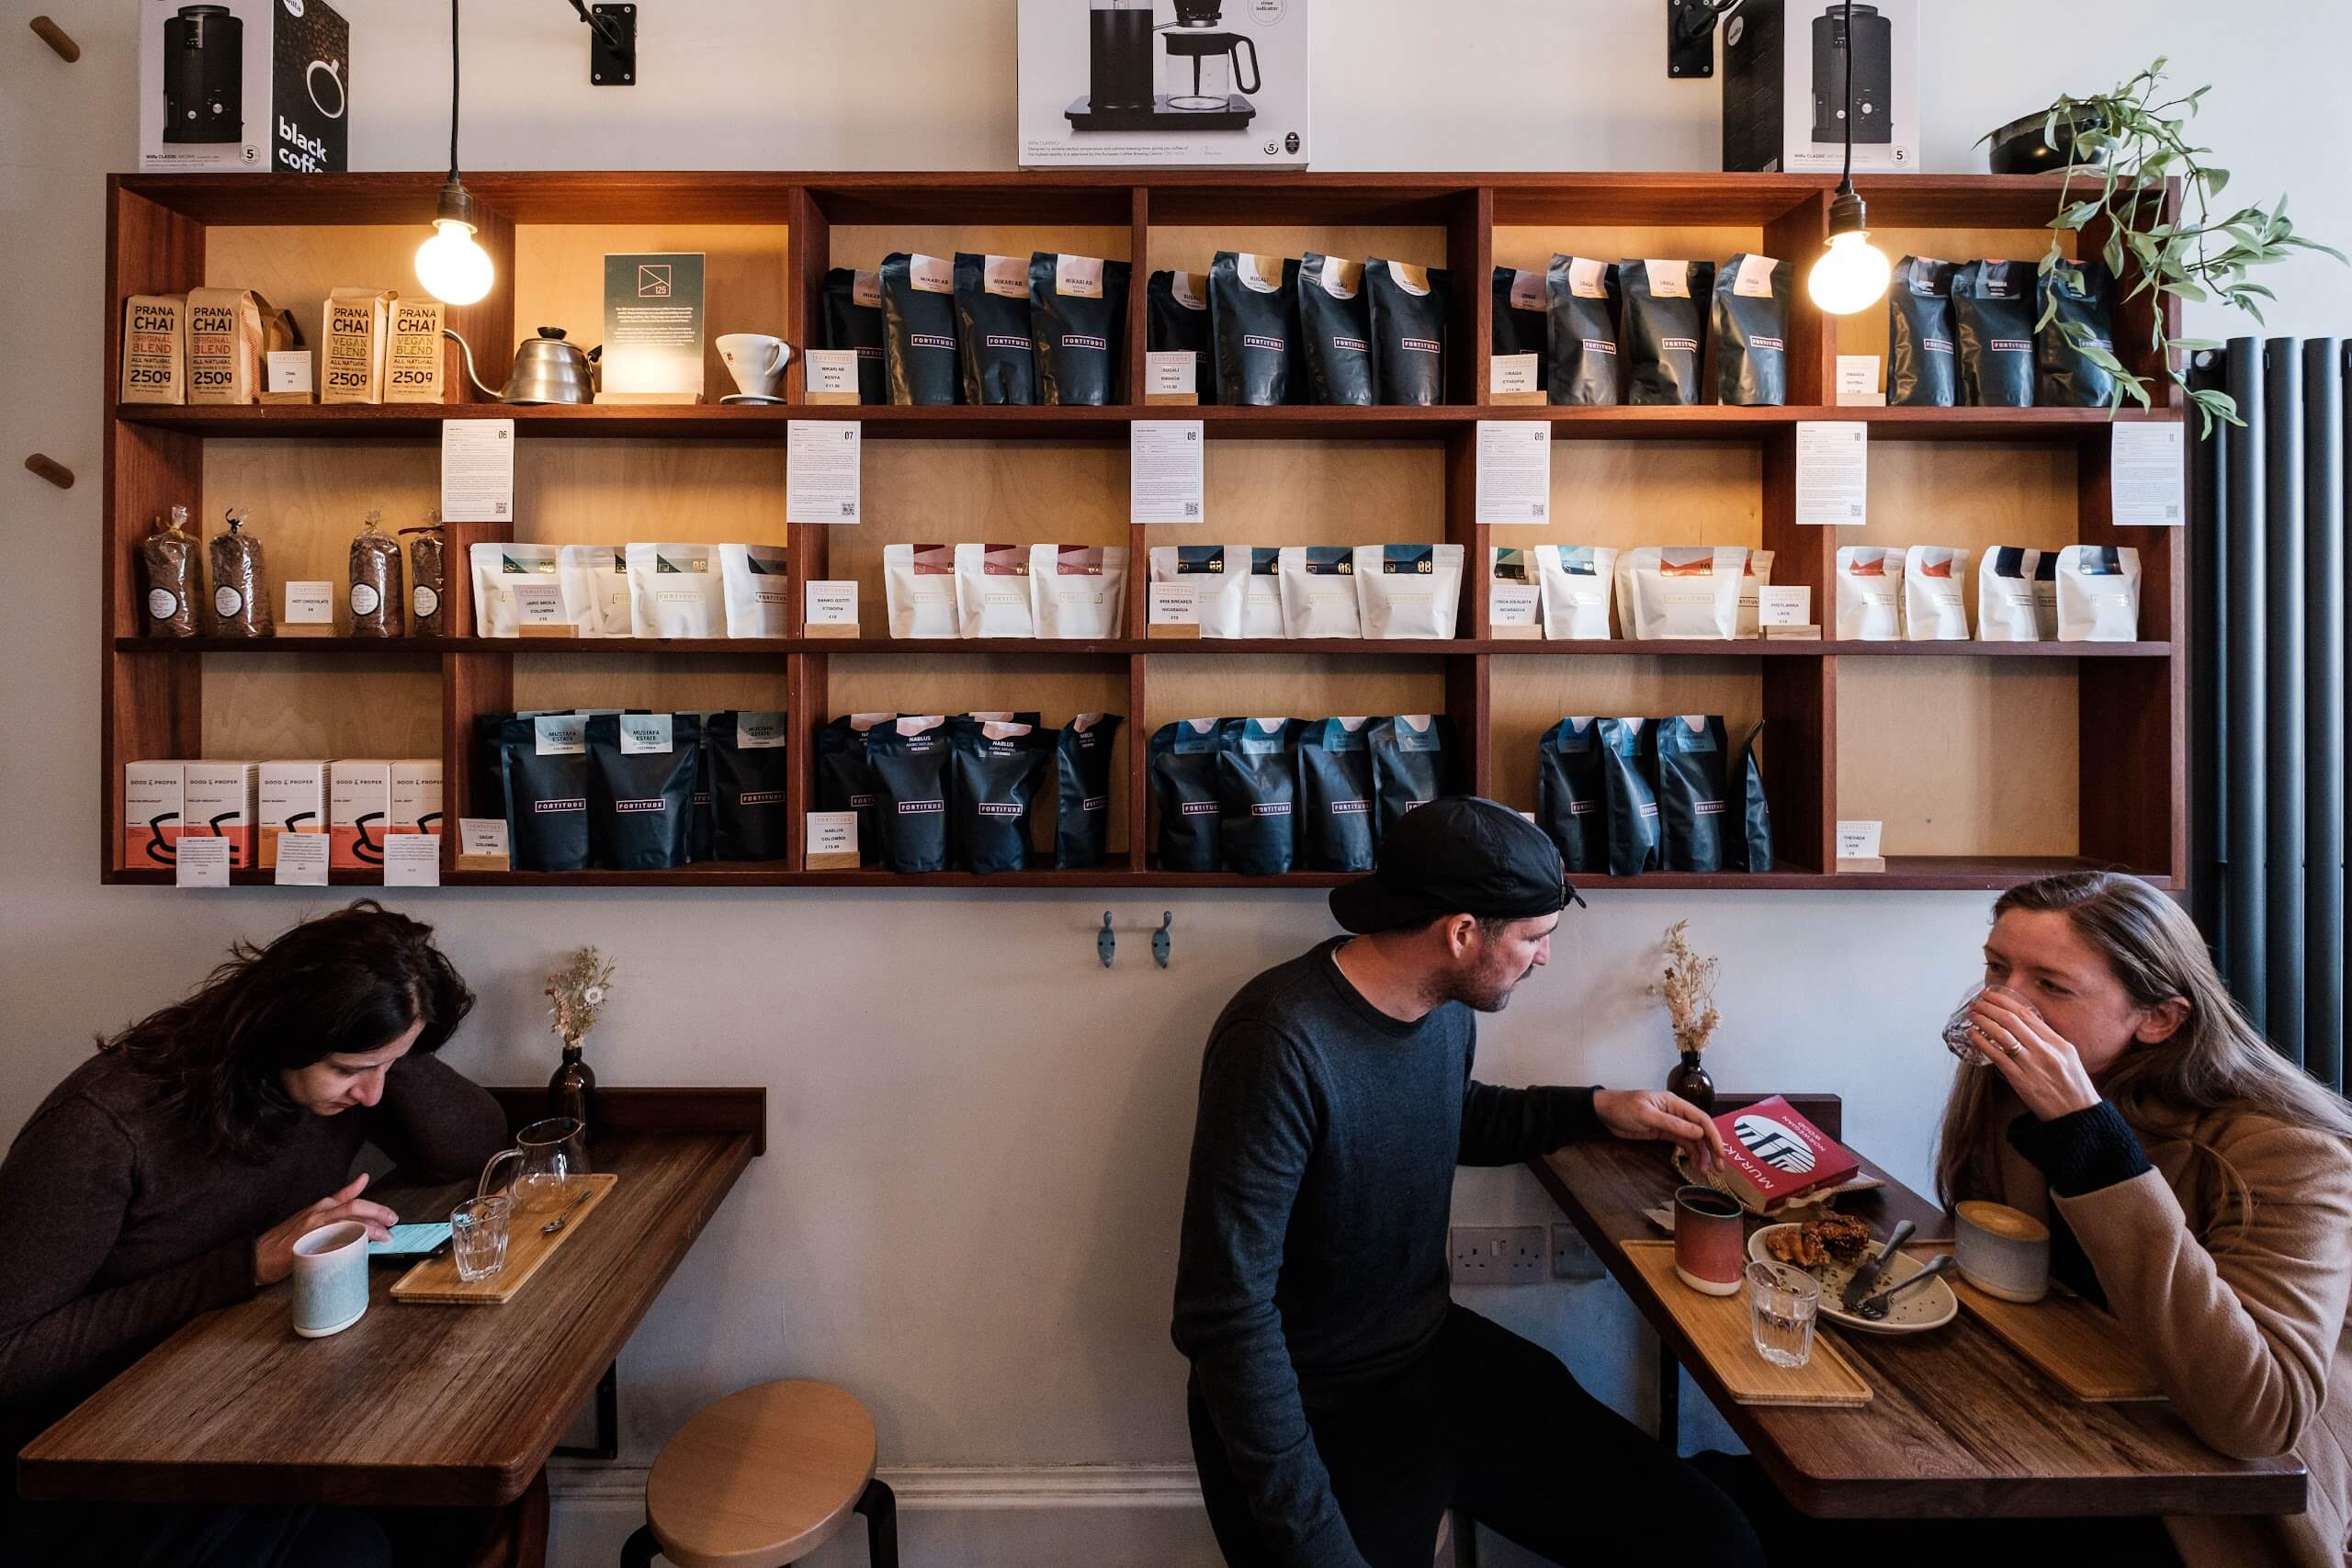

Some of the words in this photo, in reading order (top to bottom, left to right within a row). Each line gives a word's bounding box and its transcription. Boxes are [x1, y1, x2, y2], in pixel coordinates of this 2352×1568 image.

[279, 115, 327, 162] black
[246, 149, 254, 159] 5
[1896, 150, 1904, 160] 5
[655, 285, 667, 294] 125
[135, 306, 175, 316] PRANA
[194, 307, 232, 317] PRANA
[334, 308, 369, 318] PRANA
[398, 309, 436, 318] PRANA
[134, 316, 174, 331] CHAI
[193, 318, 232, 331] CHAI
[333, 319, 369, 334] CHAI
[397, 319, 435, 332] CHAI
[133, 334, 172, 344] ORIGINAL
[193, 336, 230, 344] ORIGINAL
[332, 337, 367, 348] VEGAN
[397, 337, 433, 346] VEGAN
[914, 337, 954, 347] FORTITUDE
[989, 339, 1029, 347] FORTITUDE
[1065, 338, 1103, 347] FORTITUDE
[1247, 337, 1281, 348] FORTITUDE
[1336, 339, 1368, 349] FORTITUDE
[132, 343, 172, 354] BLEND
[193, 345, 231, 354] BLEND
[396, 346, 433, 355] BLEND
[1405, 341, 1438, 350] FORTITUDE
[1585, 342, 1614, 351] FORTITUDE
[332, 346, 367, 357] BLEND
[130, 369, 171, 383] 250g
[194, 371, 232, 385] 250g
[329, 372, 367, 386] 250g
[392, 370, 433, 384] 250g
[498, 430, 507, 439] 06
[845, 430, 853, 439] 07
[1187, 432, 1196, 441] 08
[1535, 432, 1543, 441] 09
[1418, 561, 1432, 573] 08
[743, 793, 782, 802] FORTITUDE
[1255, 805, 1289, 813] FORTITUDE
[1781, 1116, 1826, 1152] NORWEGIAN
[1798, 1122, 1822, 1141] WOOD
